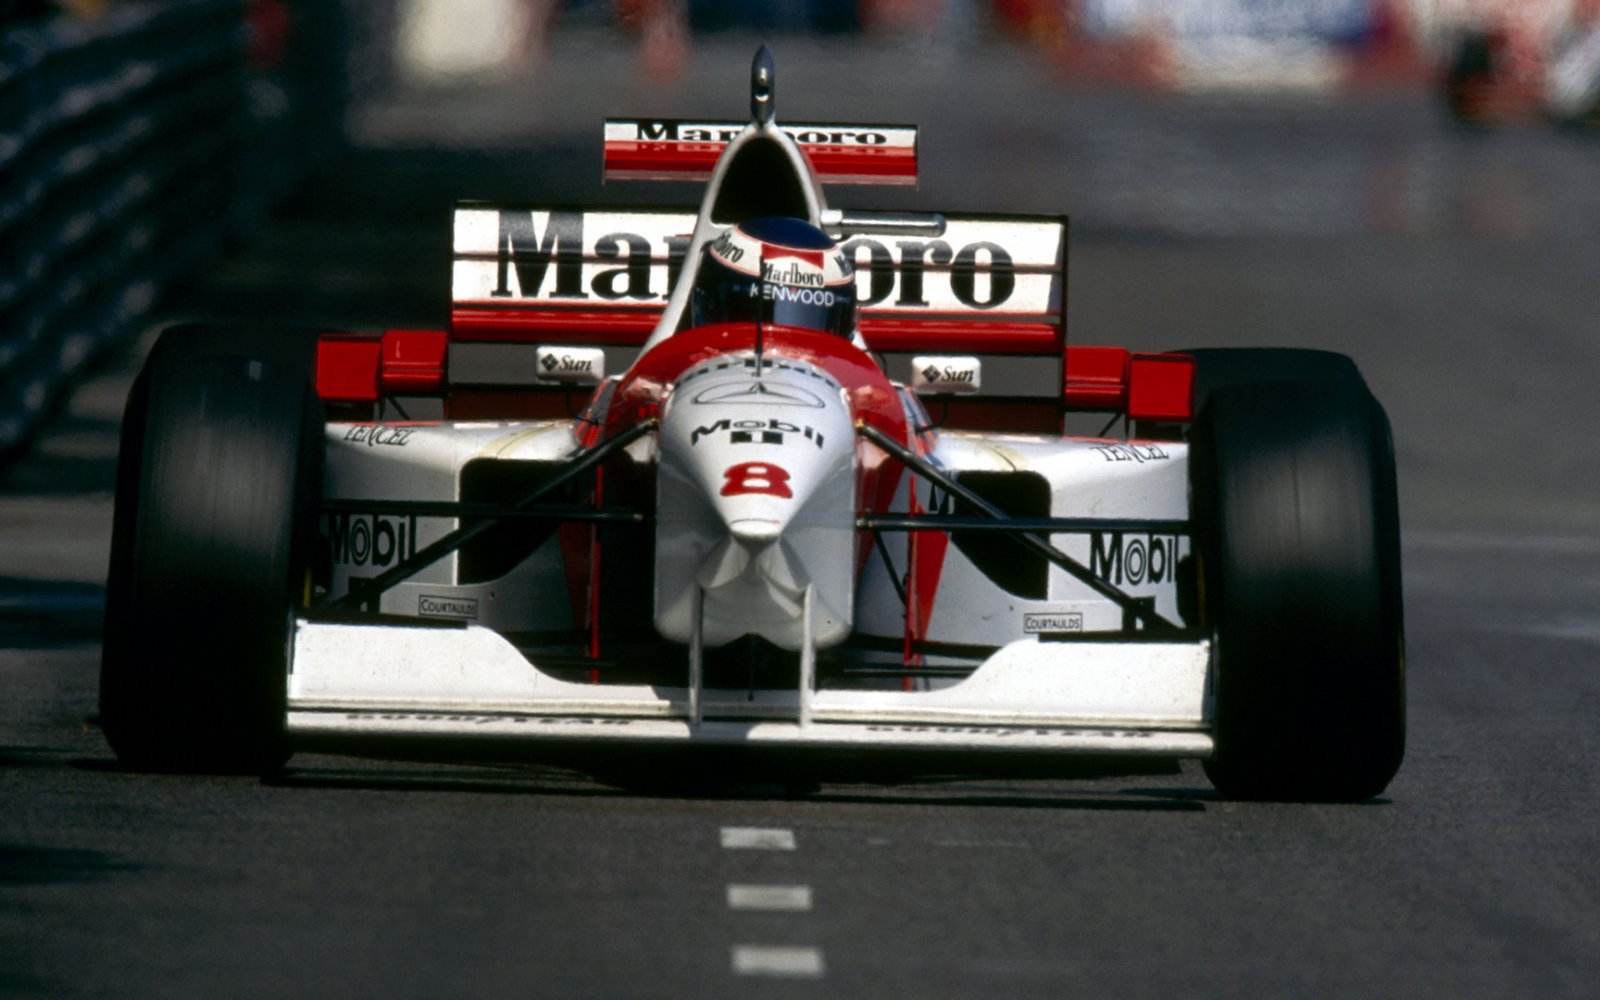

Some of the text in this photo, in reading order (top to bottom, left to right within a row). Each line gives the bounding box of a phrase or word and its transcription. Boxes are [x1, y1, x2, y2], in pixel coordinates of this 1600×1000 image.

[637, 122, 887, 145] Maroro
[491, 211, 1015, 309] Maoro
[762, 261, 824, 286] Marlboro
[749, 282, 834, 307] KENWOOD
[560, 354, 592, 372] Sun
[941, 365, 974, 382] Sun
[691, 419, 824, 449] Mobil
[720, 461, 793, 499] 8
[1090, 532, 1180, 585] Mobil
